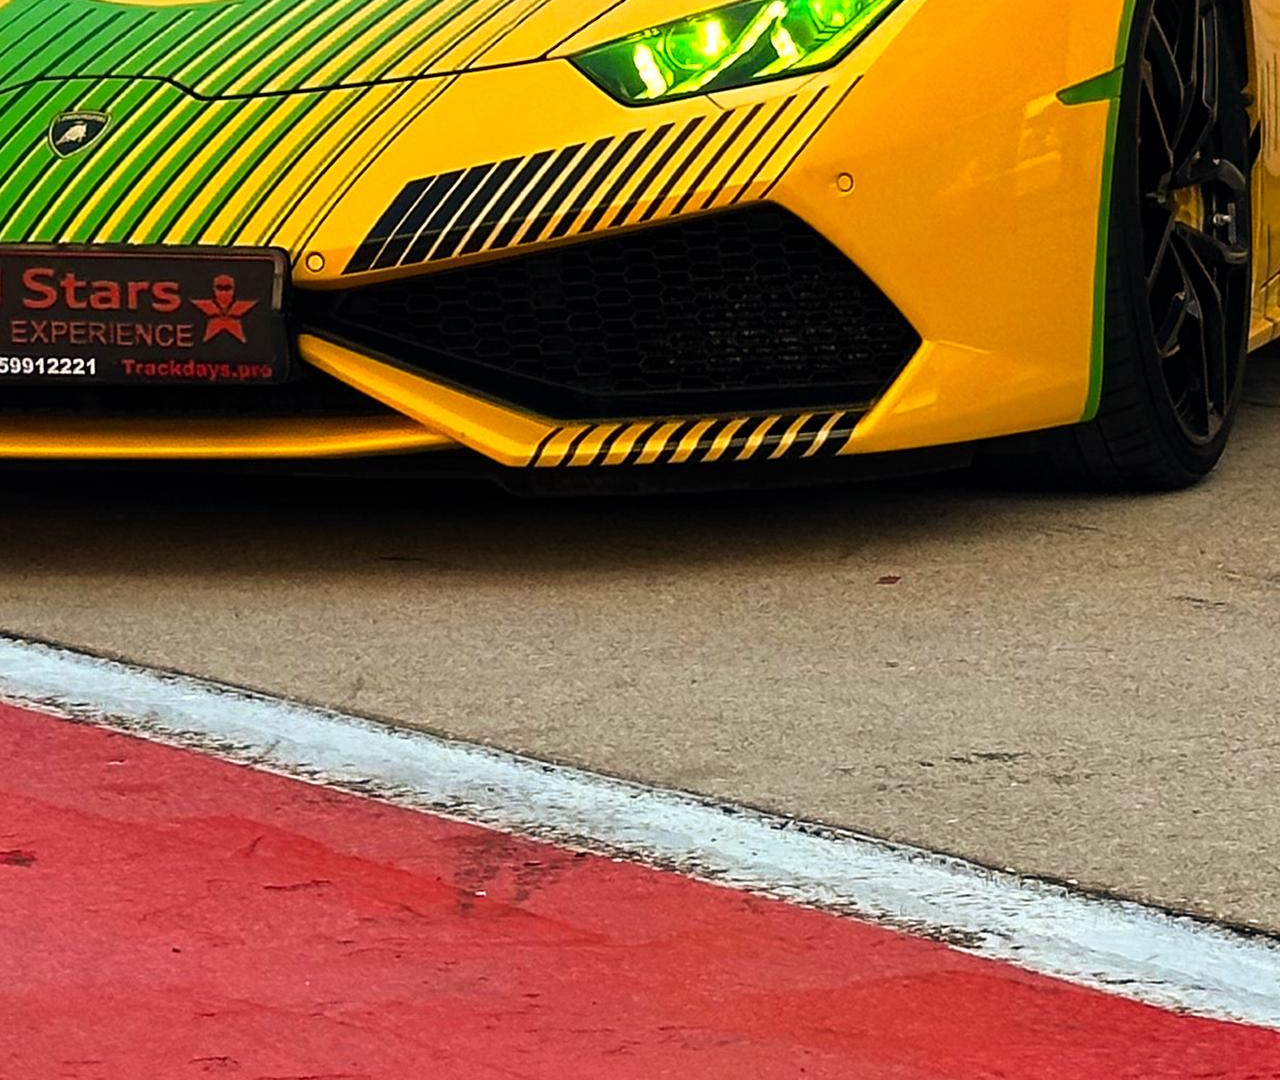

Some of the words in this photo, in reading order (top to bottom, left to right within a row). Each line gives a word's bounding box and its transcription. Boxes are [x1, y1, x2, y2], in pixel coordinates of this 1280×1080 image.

[21, 266, 182, 313] Stars
[11, 320, 195, 347] EXPERIENCE
[122, 358, 273, 382] Trackdays.pro
